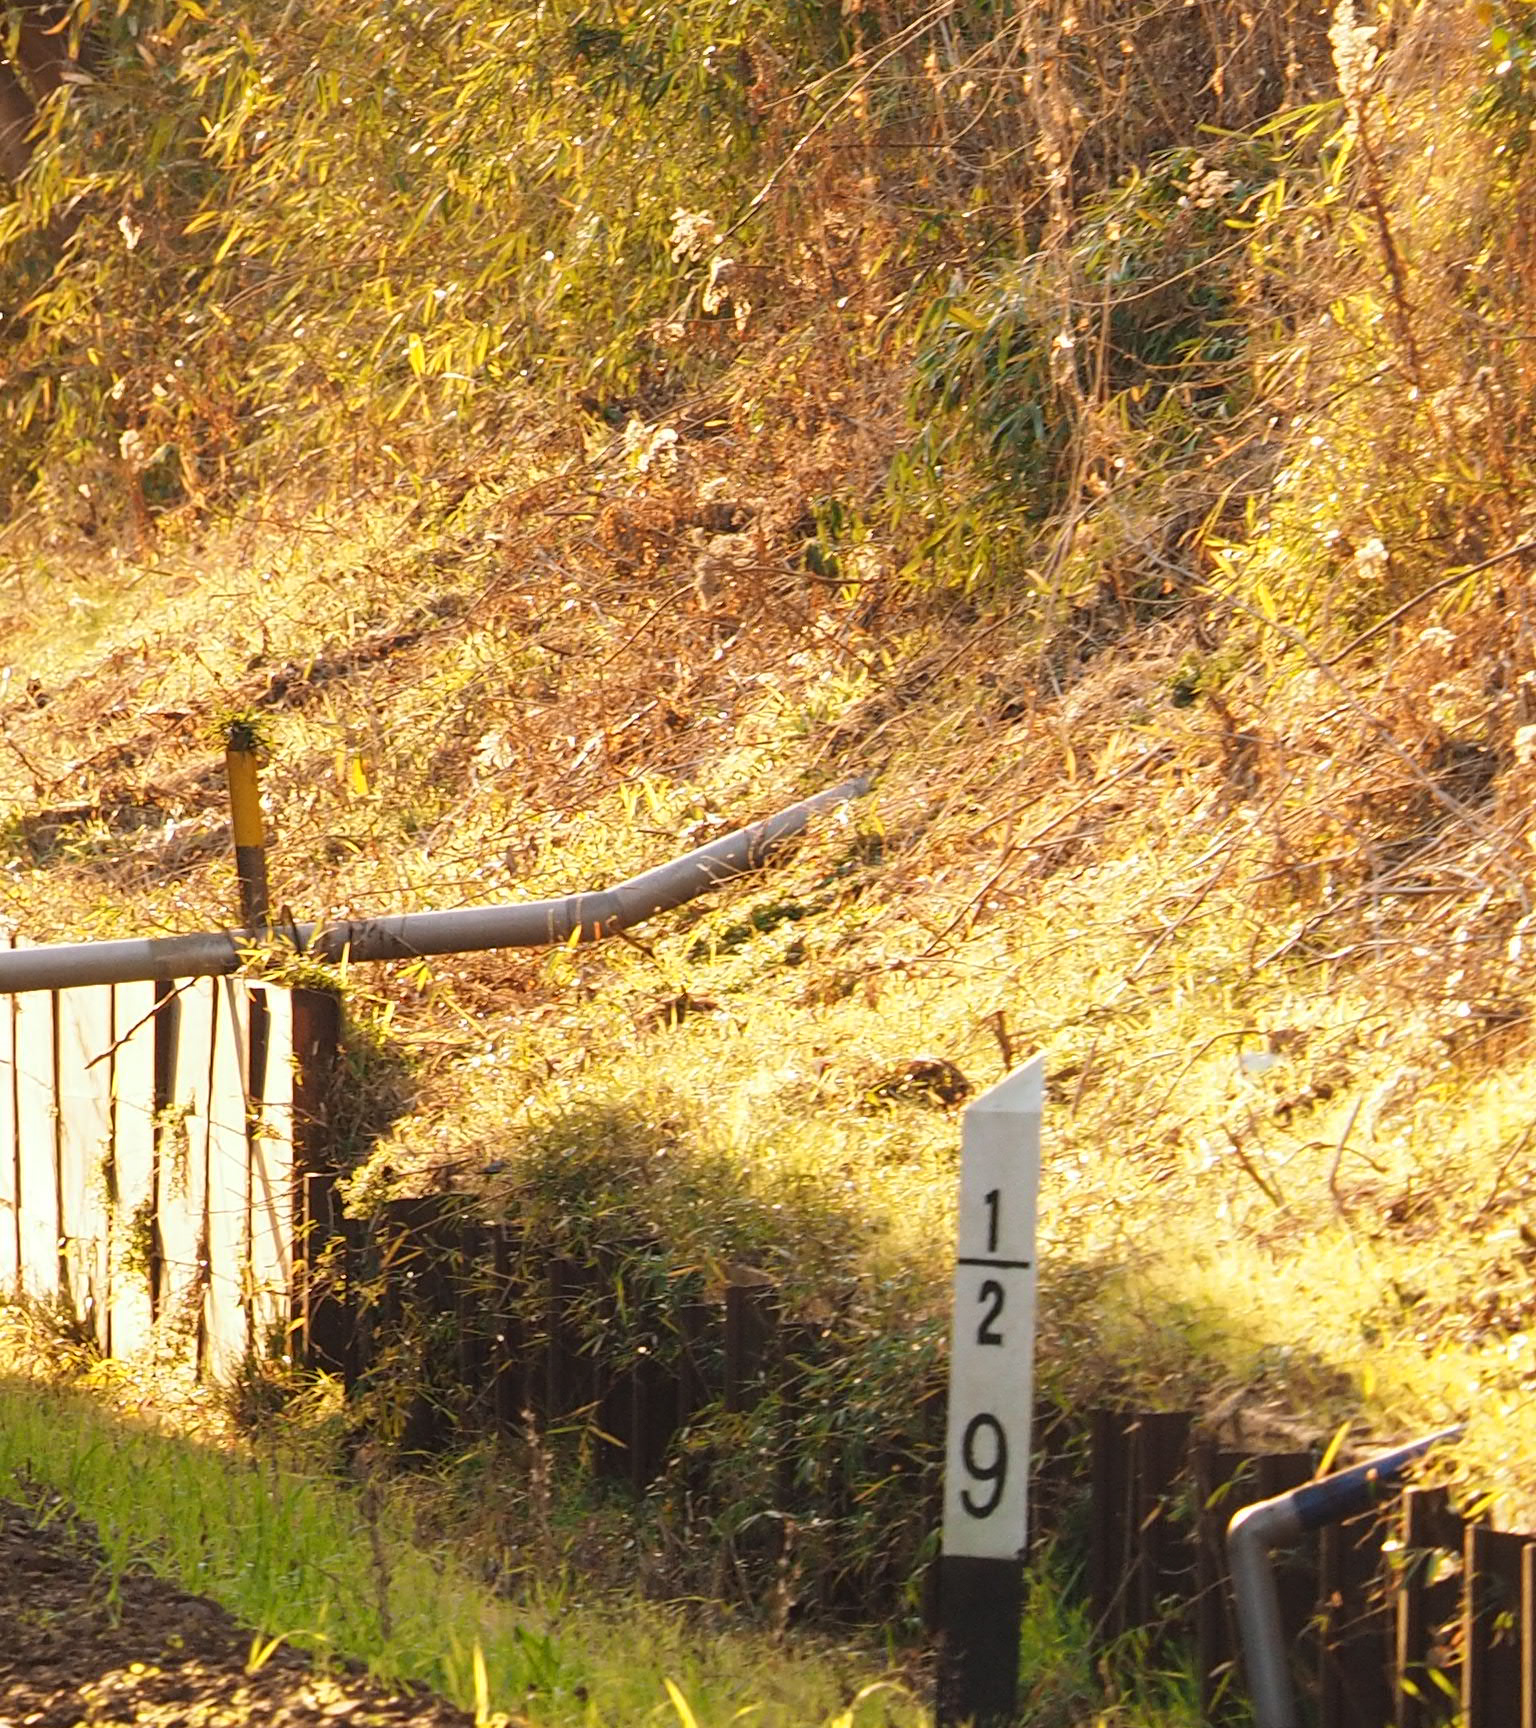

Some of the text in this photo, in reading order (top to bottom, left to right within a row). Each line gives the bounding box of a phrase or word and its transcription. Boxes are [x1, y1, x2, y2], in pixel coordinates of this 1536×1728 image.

[983, 1189, 1000, 1252] 1
[977, 1280, 1004, 1346] 2
[960, 1413, 1009, 1519] 9
